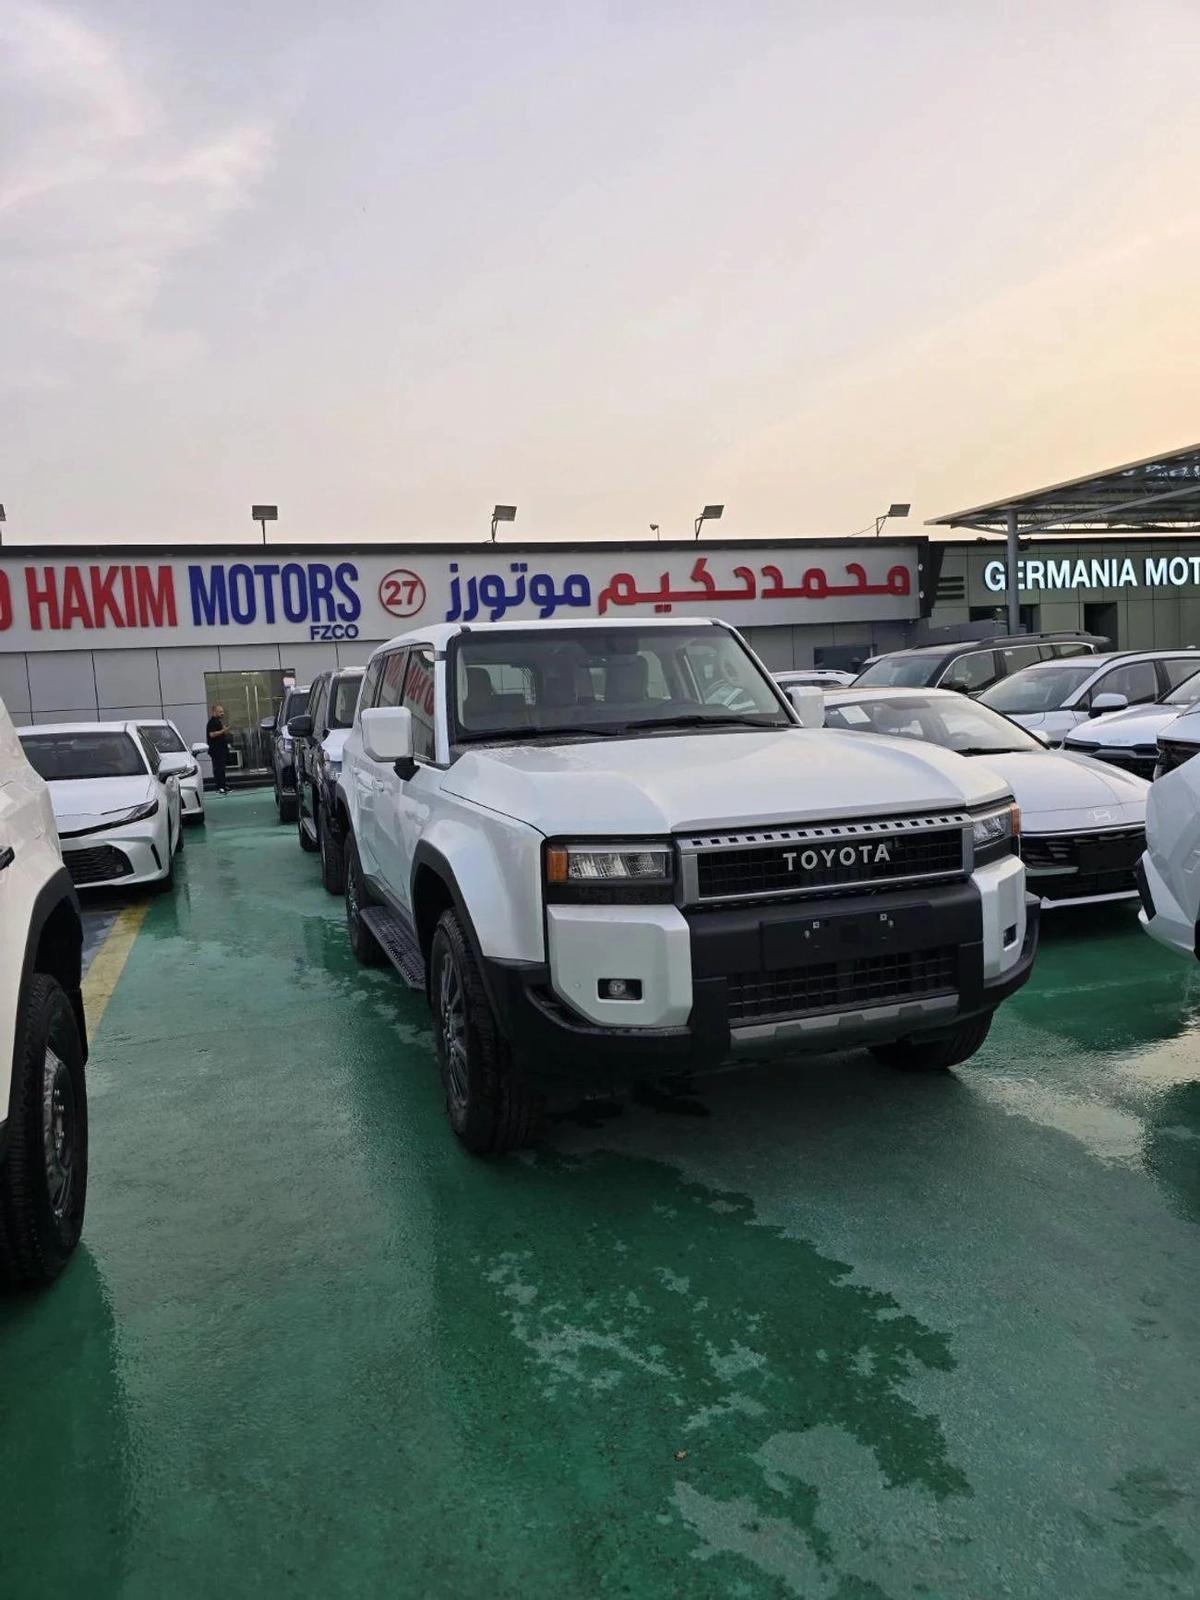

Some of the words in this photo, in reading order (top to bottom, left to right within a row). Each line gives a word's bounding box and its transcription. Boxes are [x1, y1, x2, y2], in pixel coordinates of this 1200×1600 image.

[25, 565, 178, 631] HAKIM
[188, 562, 361, 626] MOTORS
[385, 581, 418, 606] 27
[446, 563, 591, 622] موتورز
[310, 625, 359, 640] FZCO
[783, 843, 891, 871] TOYOTA
